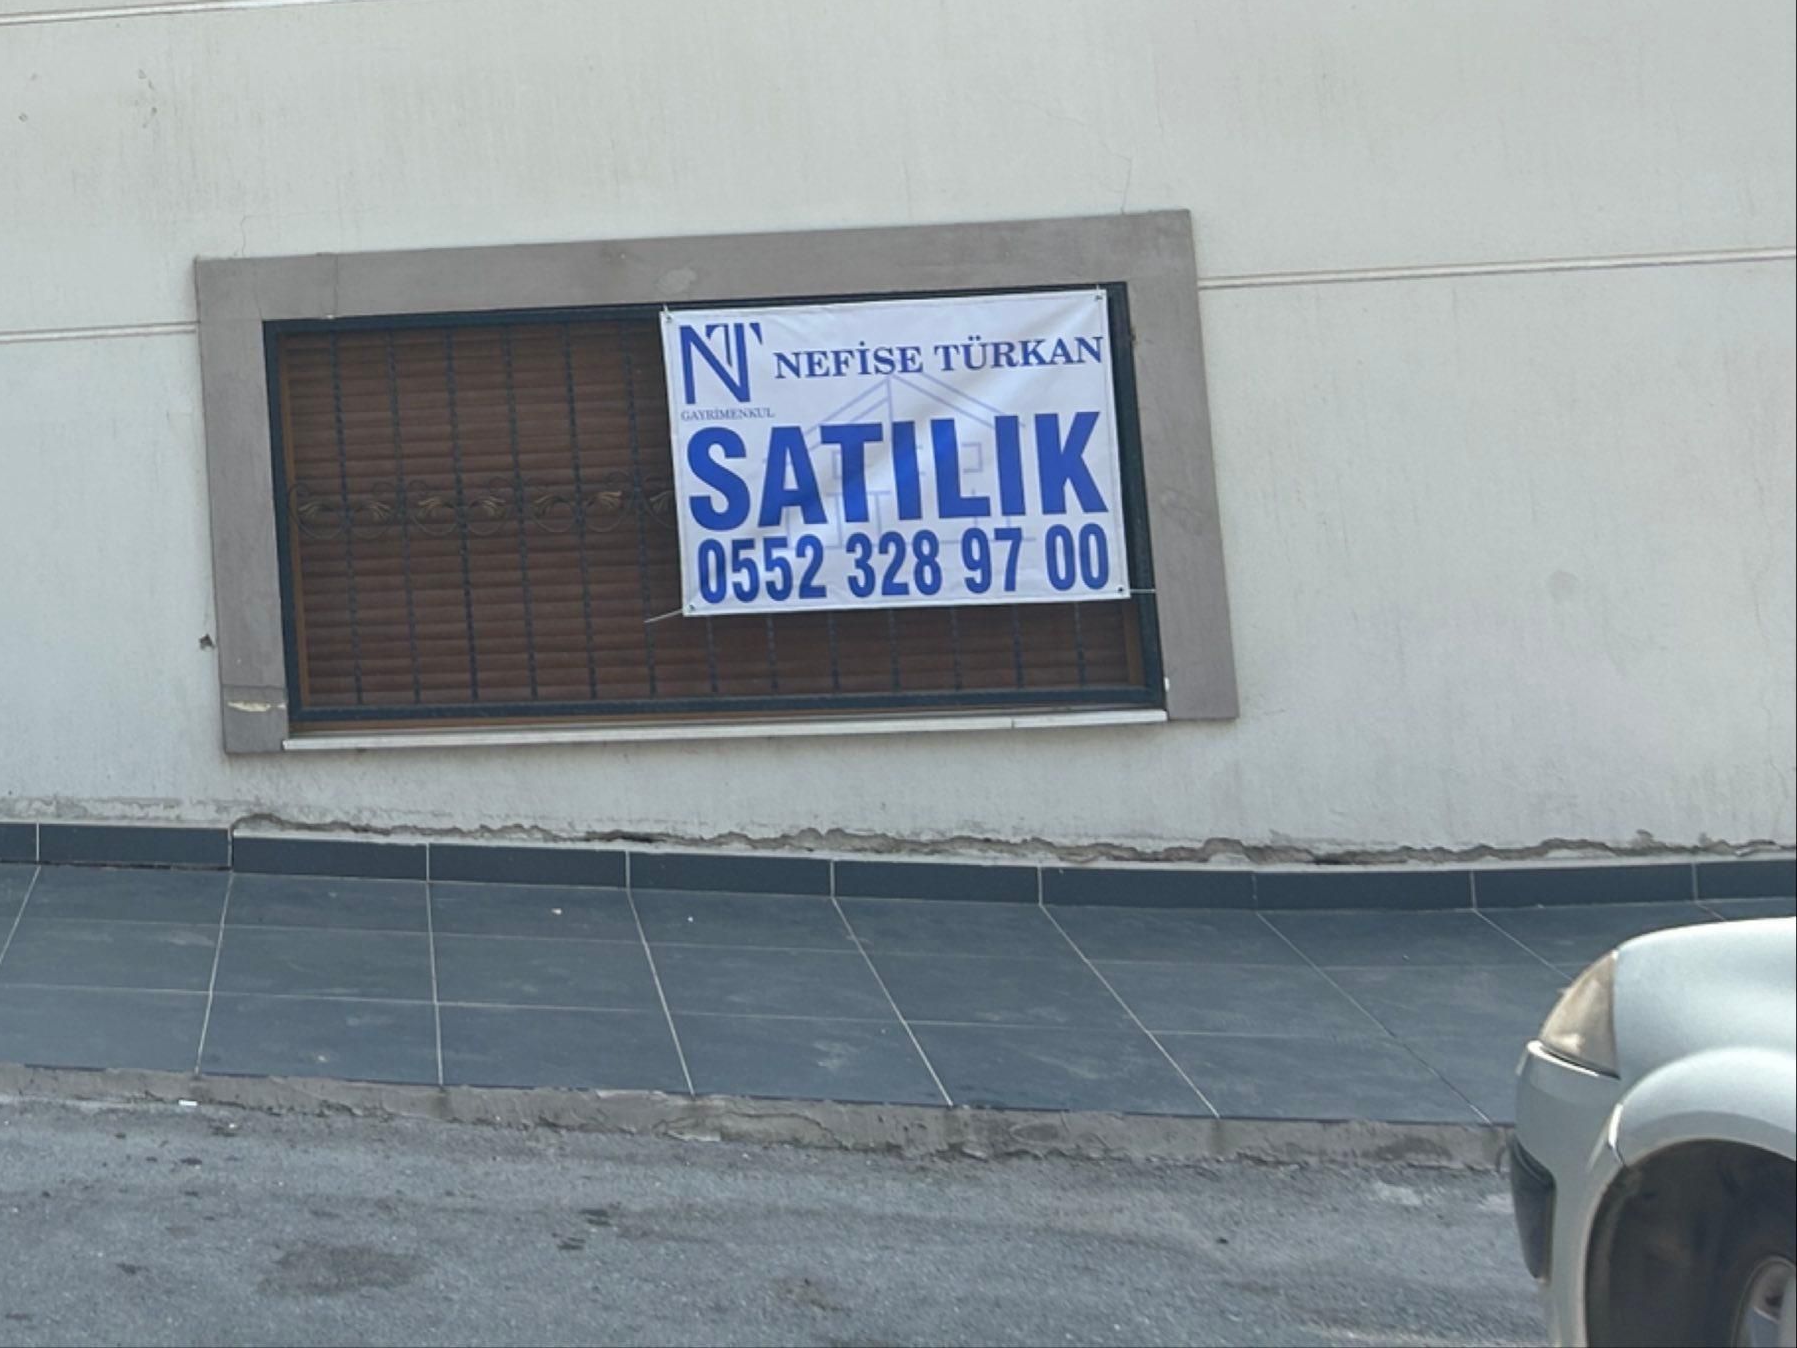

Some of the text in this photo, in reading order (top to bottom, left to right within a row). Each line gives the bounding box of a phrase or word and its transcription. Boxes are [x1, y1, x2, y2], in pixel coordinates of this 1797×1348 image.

[774, 335, 1104, 379] NEFİSE TÜRKAN
[687, 411, 1108, 531] SATILIK
[698, 523, 1109, 603] 0552 328 97 00
